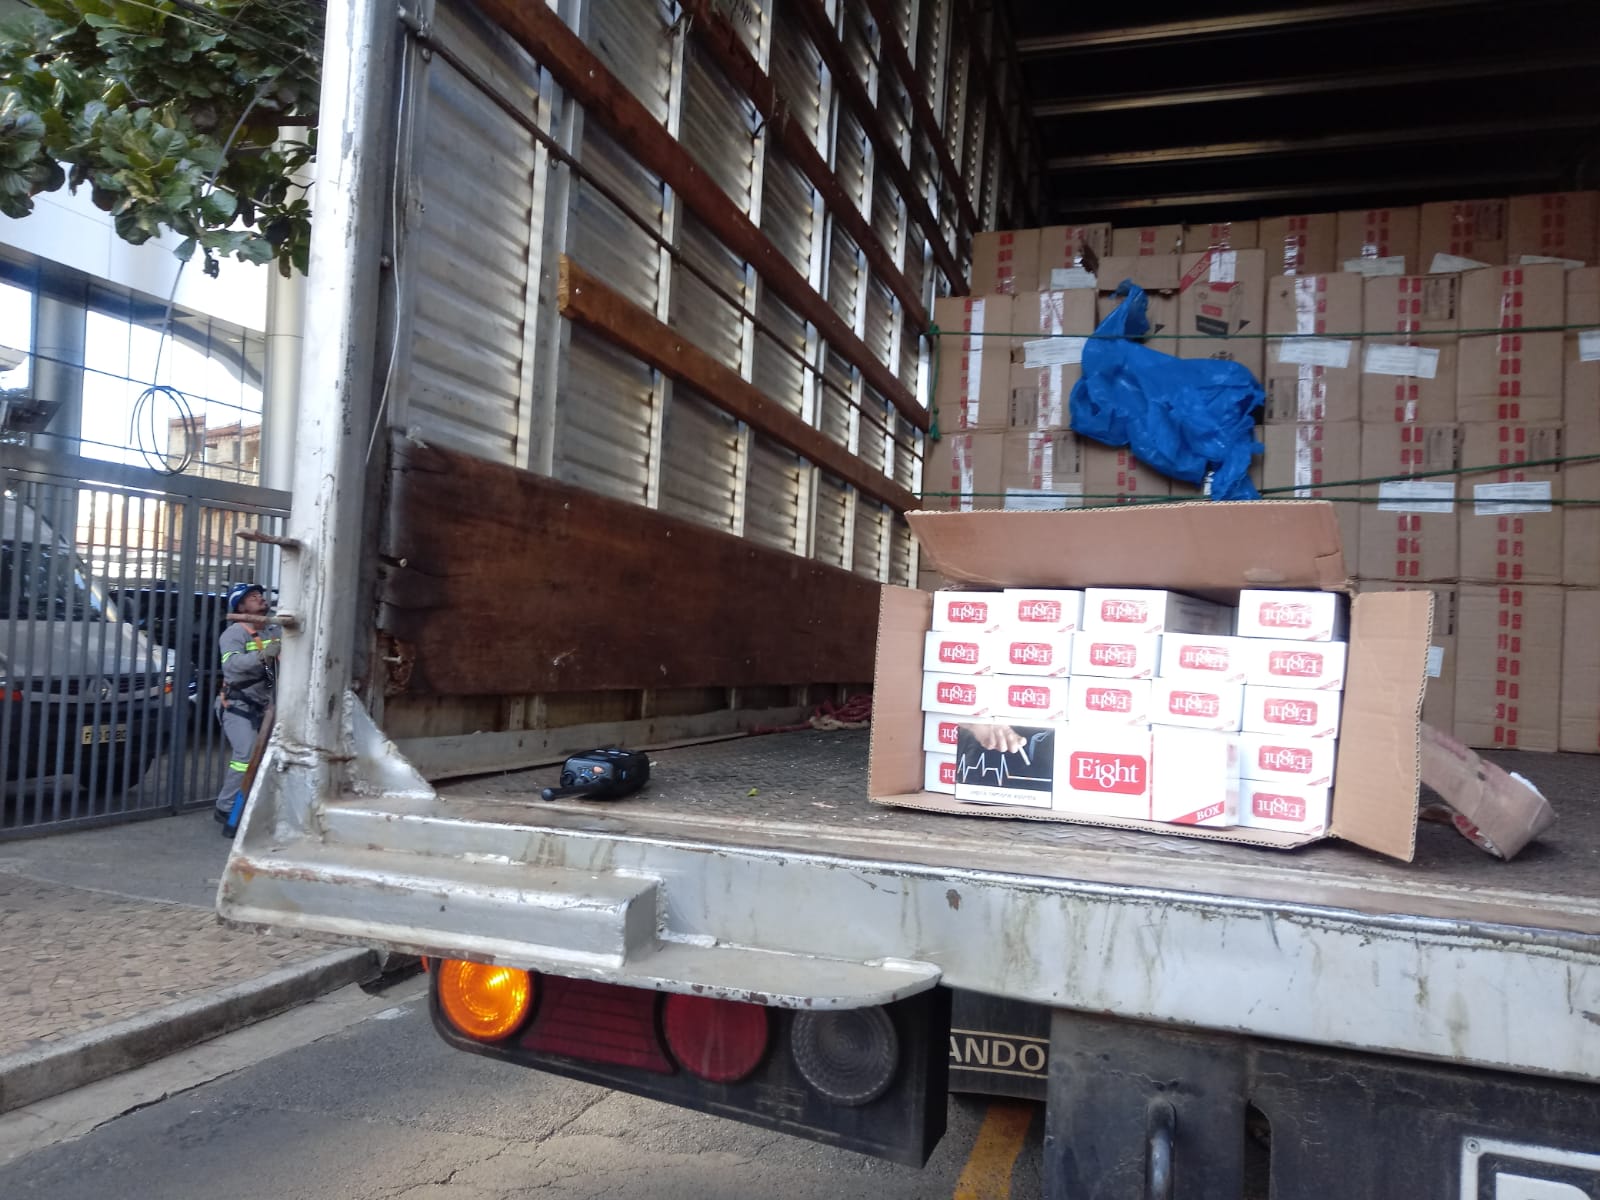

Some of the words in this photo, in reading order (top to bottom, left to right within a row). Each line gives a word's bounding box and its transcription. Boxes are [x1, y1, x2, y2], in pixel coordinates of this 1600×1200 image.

[951, 603, 985, 621] Eight
[1022, 602, 1057, 620] Eight
[1105, 602, 1147, 621] Eight
[1264, 604, 1310, 625] Eight
[943, 644, 976, 662] Eight
[1013, 644, 1048, 662] Eight
[1094, 645, 1134, 664] Eight
[1184, 648, 1228, 668] Eight
[1273, 653, 1318, 674] Eight
[941, 685, 973, 702] Eight
[1012, 688, 1046, 705] Eight
[1091, 690, 1128, 710] Eight
[1171, 693, 1215, 714] Eight
[1269, 702, 1312, 723] Eight
[1263, 749, 1307, 770] Eight
[1076, 757, 1139, 788] Eight
[1196, 804, 1220, 821] BOX
[1257, 797, 1301, 818] Eight
